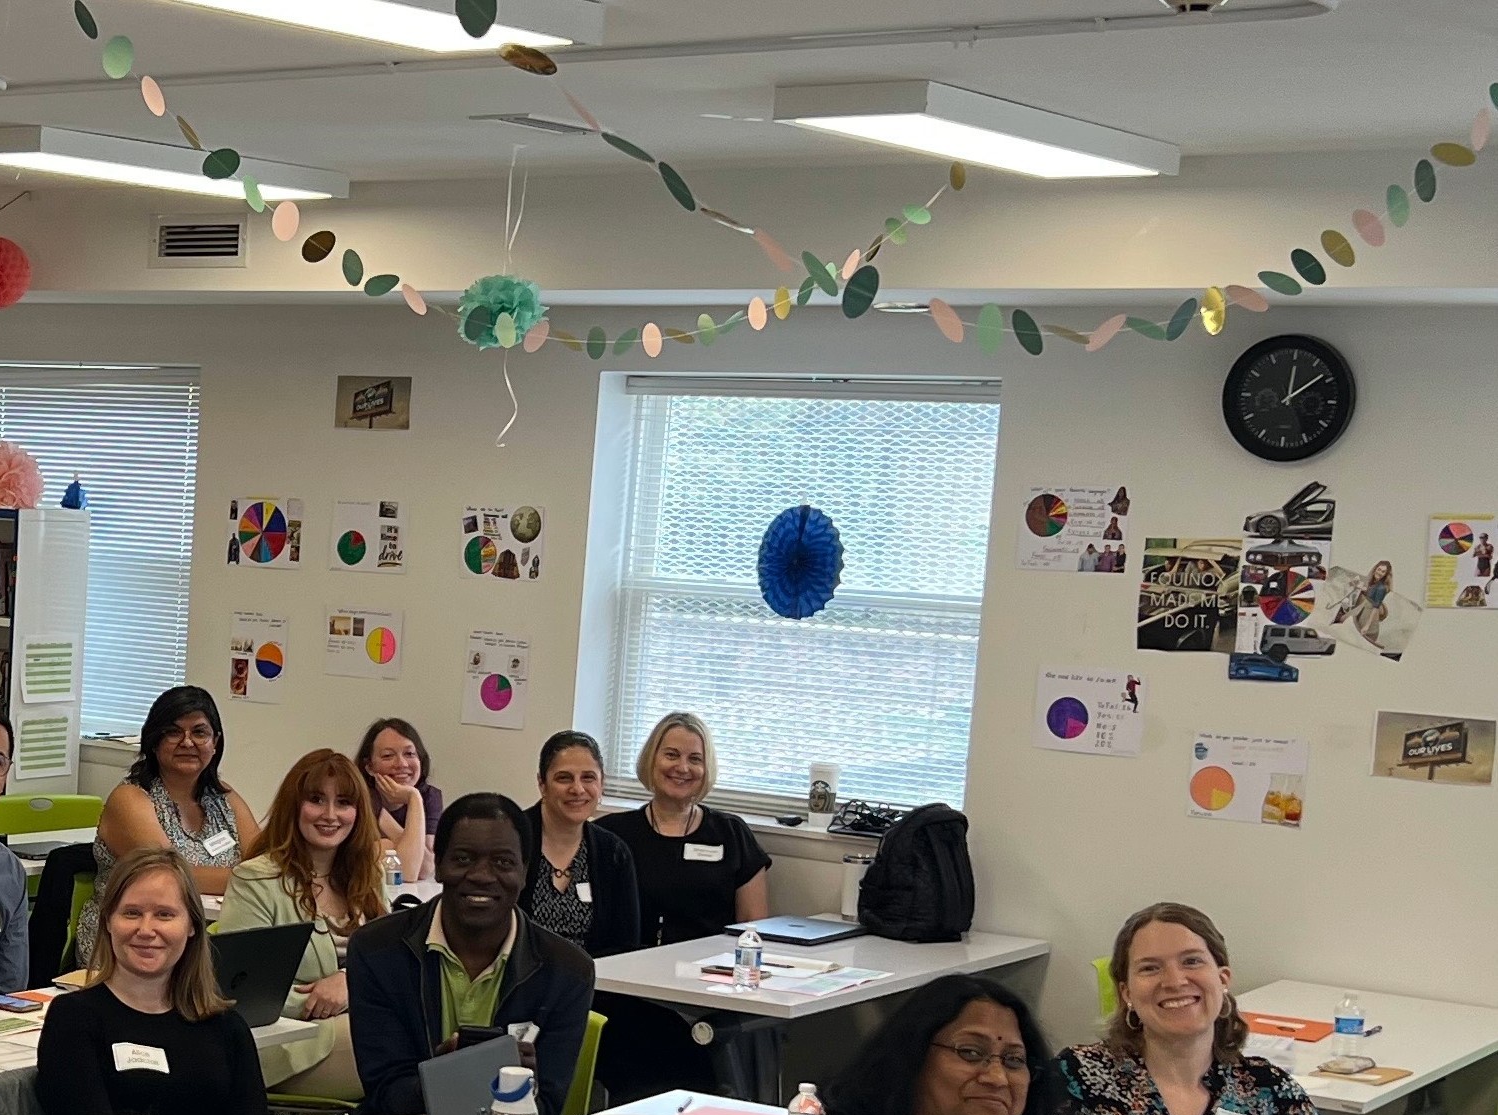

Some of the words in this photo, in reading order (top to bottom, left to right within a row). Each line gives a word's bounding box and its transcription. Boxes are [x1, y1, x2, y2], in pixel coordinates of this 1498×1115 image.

[1164, 614, 1189, 629] DO
[1193, 614, 1210, 629] IT.
[1408, 746, 1426, 756] OUR
[1427, 743, 1453, 754] LIVES
